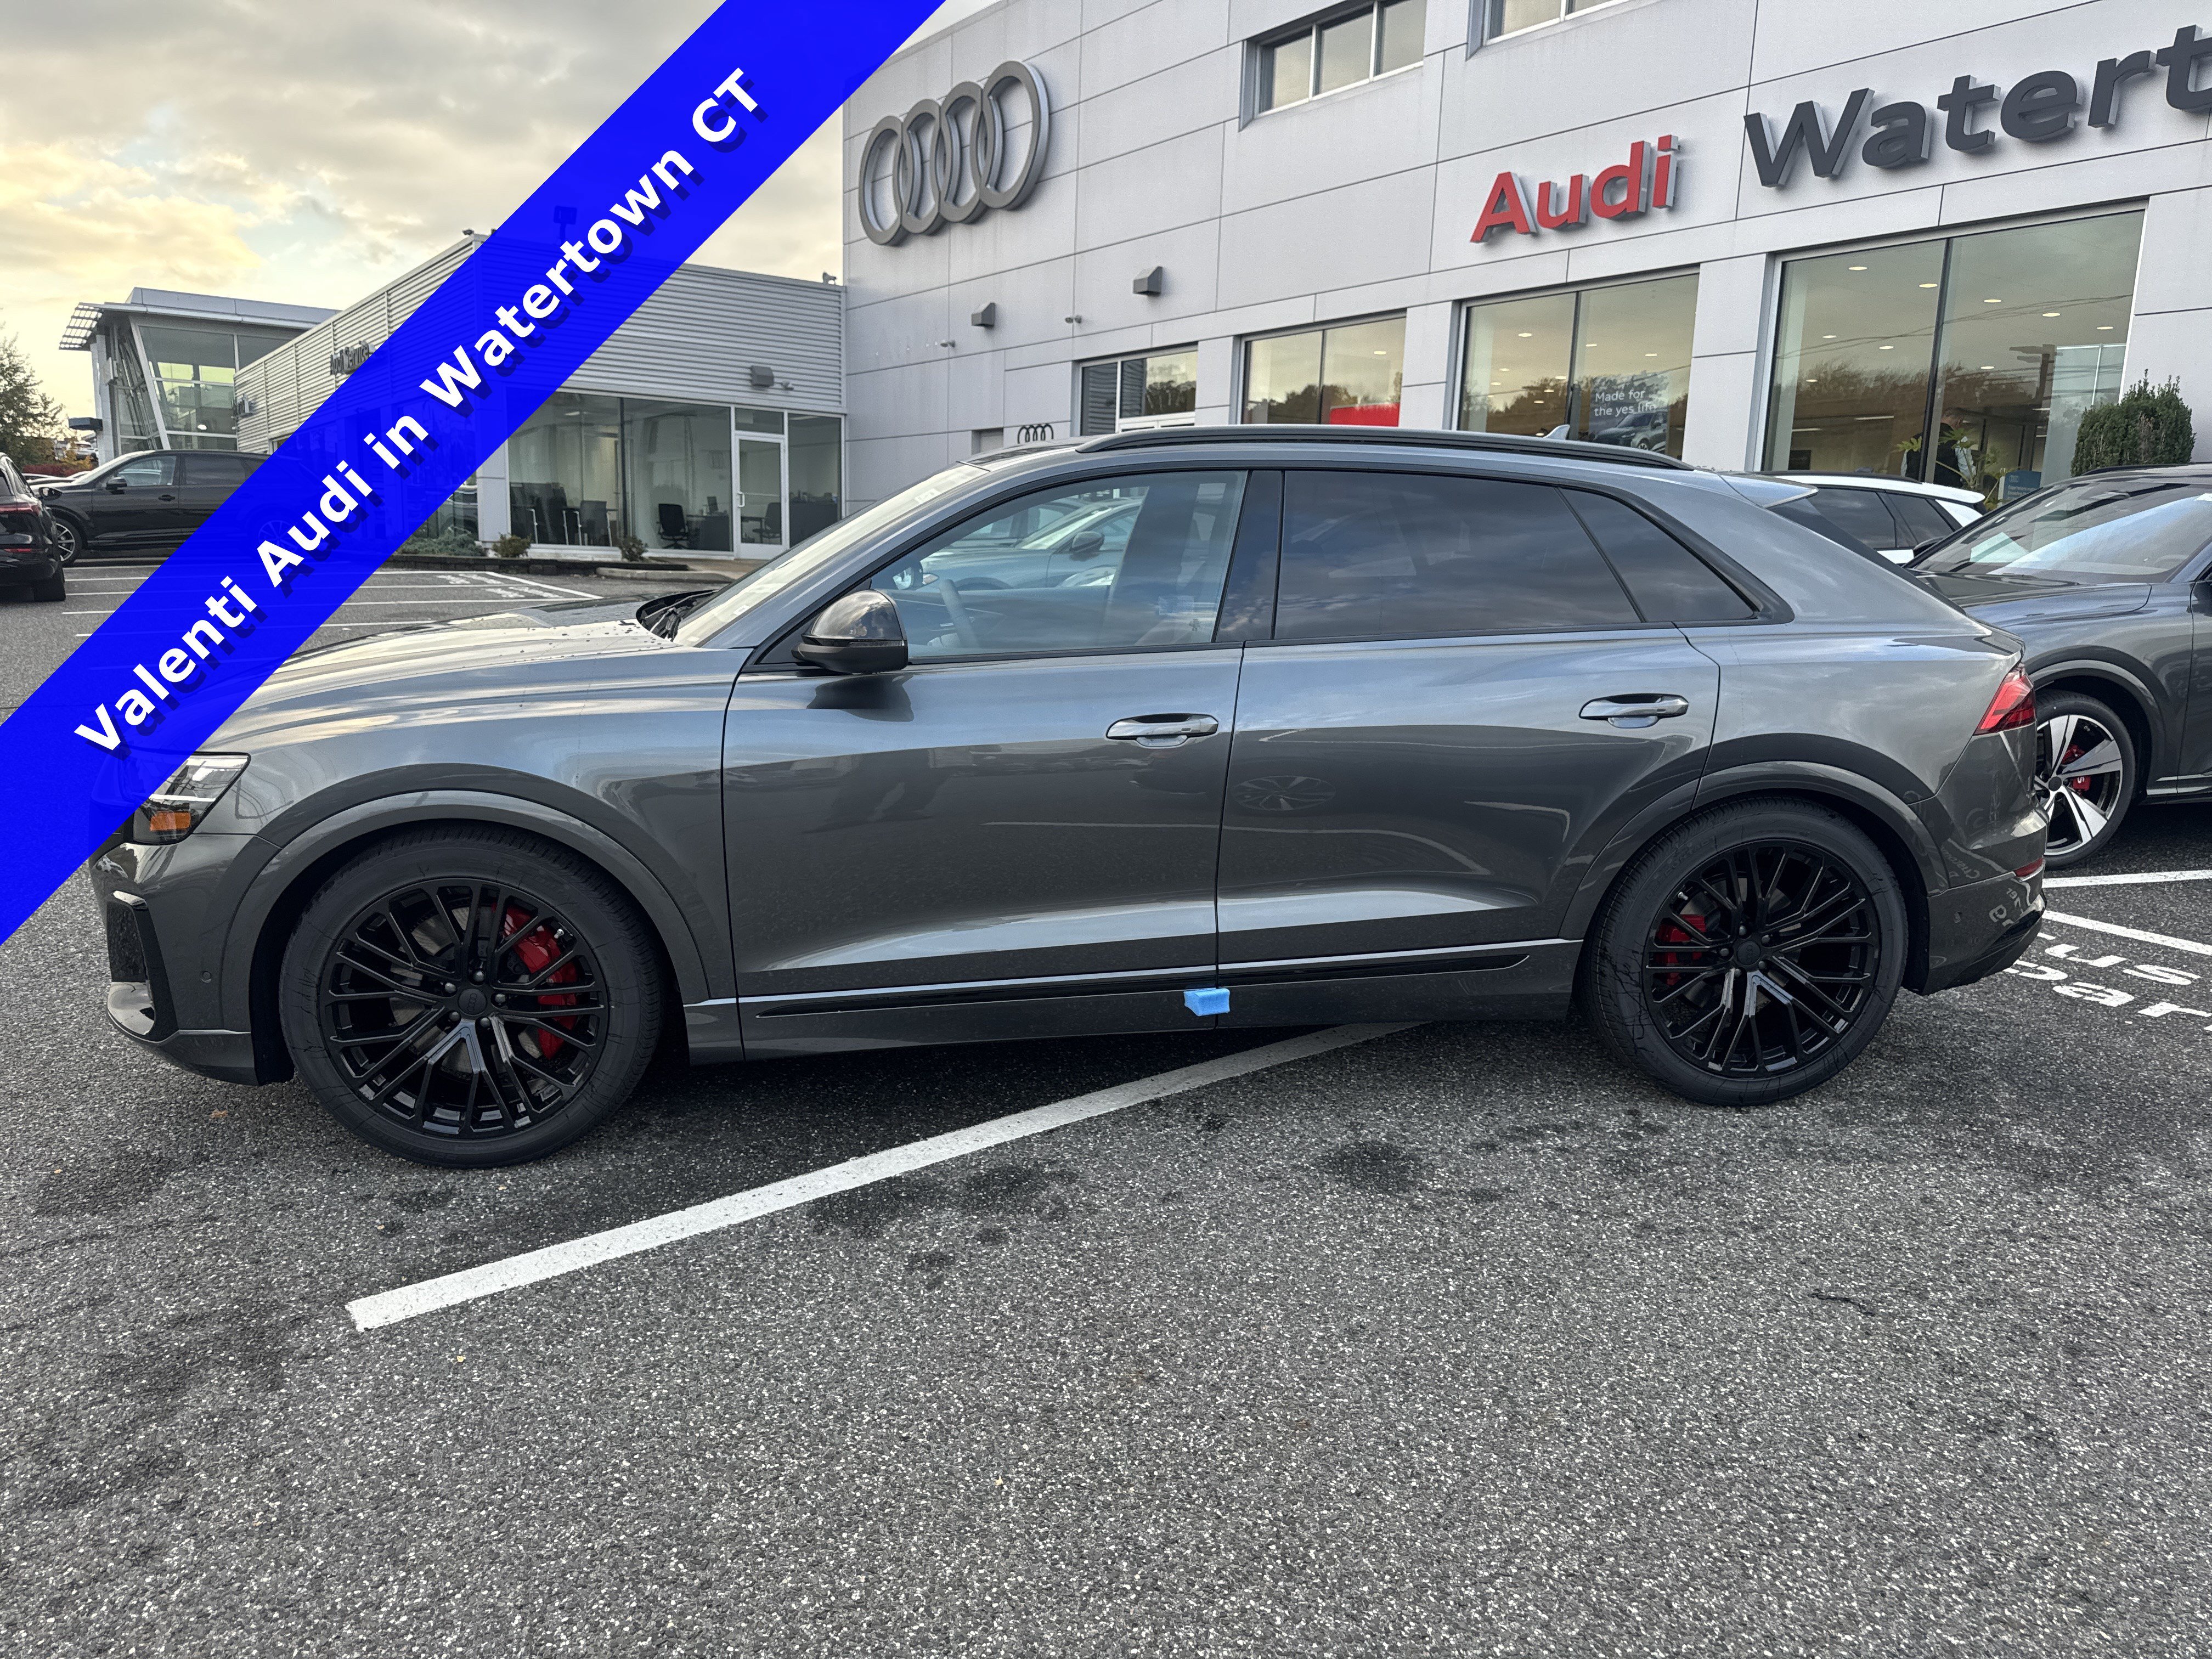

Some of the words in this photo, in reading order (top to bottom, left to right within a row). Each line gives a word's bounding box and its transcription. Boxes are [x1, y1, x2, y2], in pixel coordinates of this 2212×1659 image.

[1470, 134, 1680, 244] Audi
[1743, 25, 2212, 188] Watert
[1595, 390, 1625, 403] Made
[1628, 389, 1645, 400] for
[1594, 406, 1612, 416] the
[1615, 405, 1634, 417] yes
